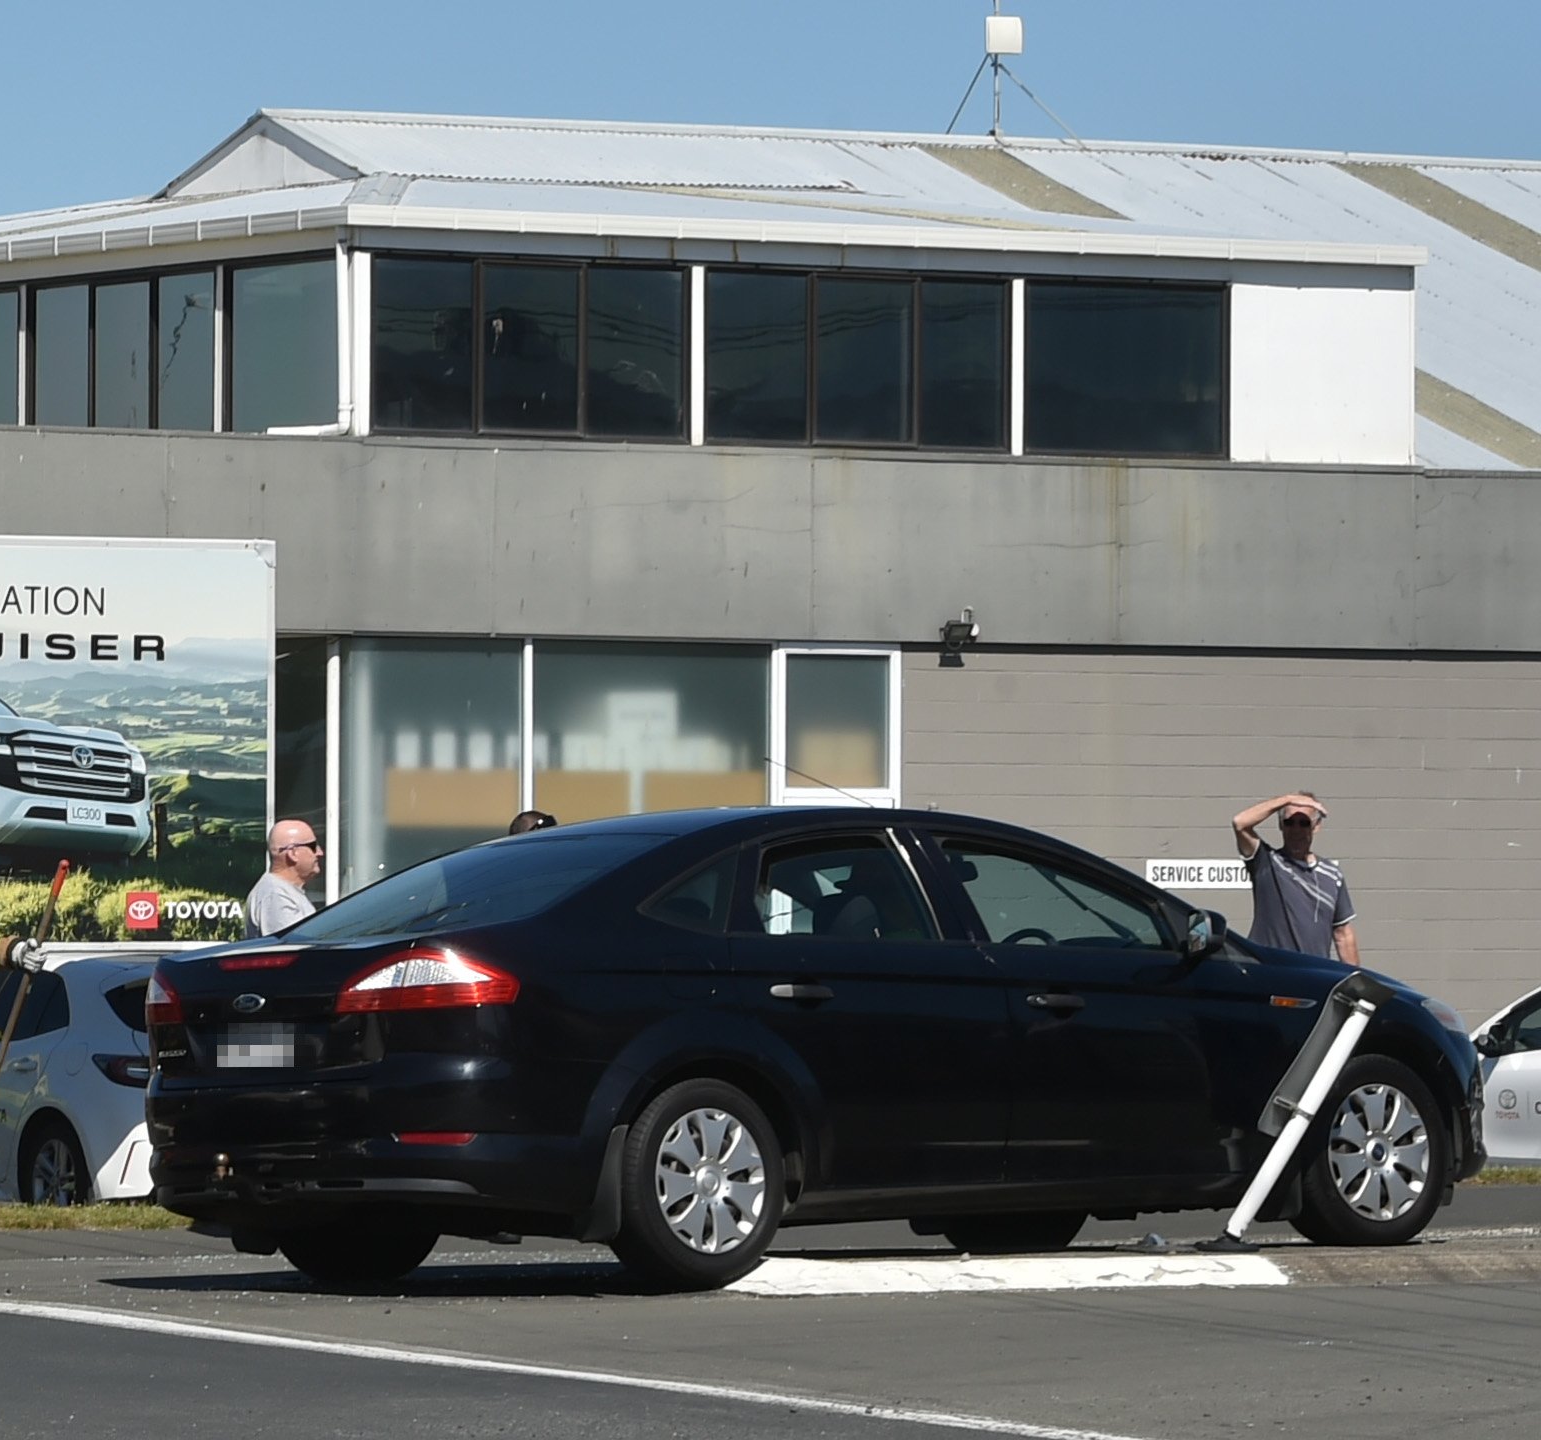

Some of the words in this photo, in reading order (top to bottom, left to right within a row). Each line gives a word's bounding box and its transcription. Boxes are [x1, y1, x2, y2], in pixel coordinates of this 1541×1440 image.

[72, 807, 102, 821] LC300
[1152, 865, 1204, 882] SERVICE
[1208, 866, 1252, 882] CUSTO
[164, 900, 244, 920] TOYOTA
